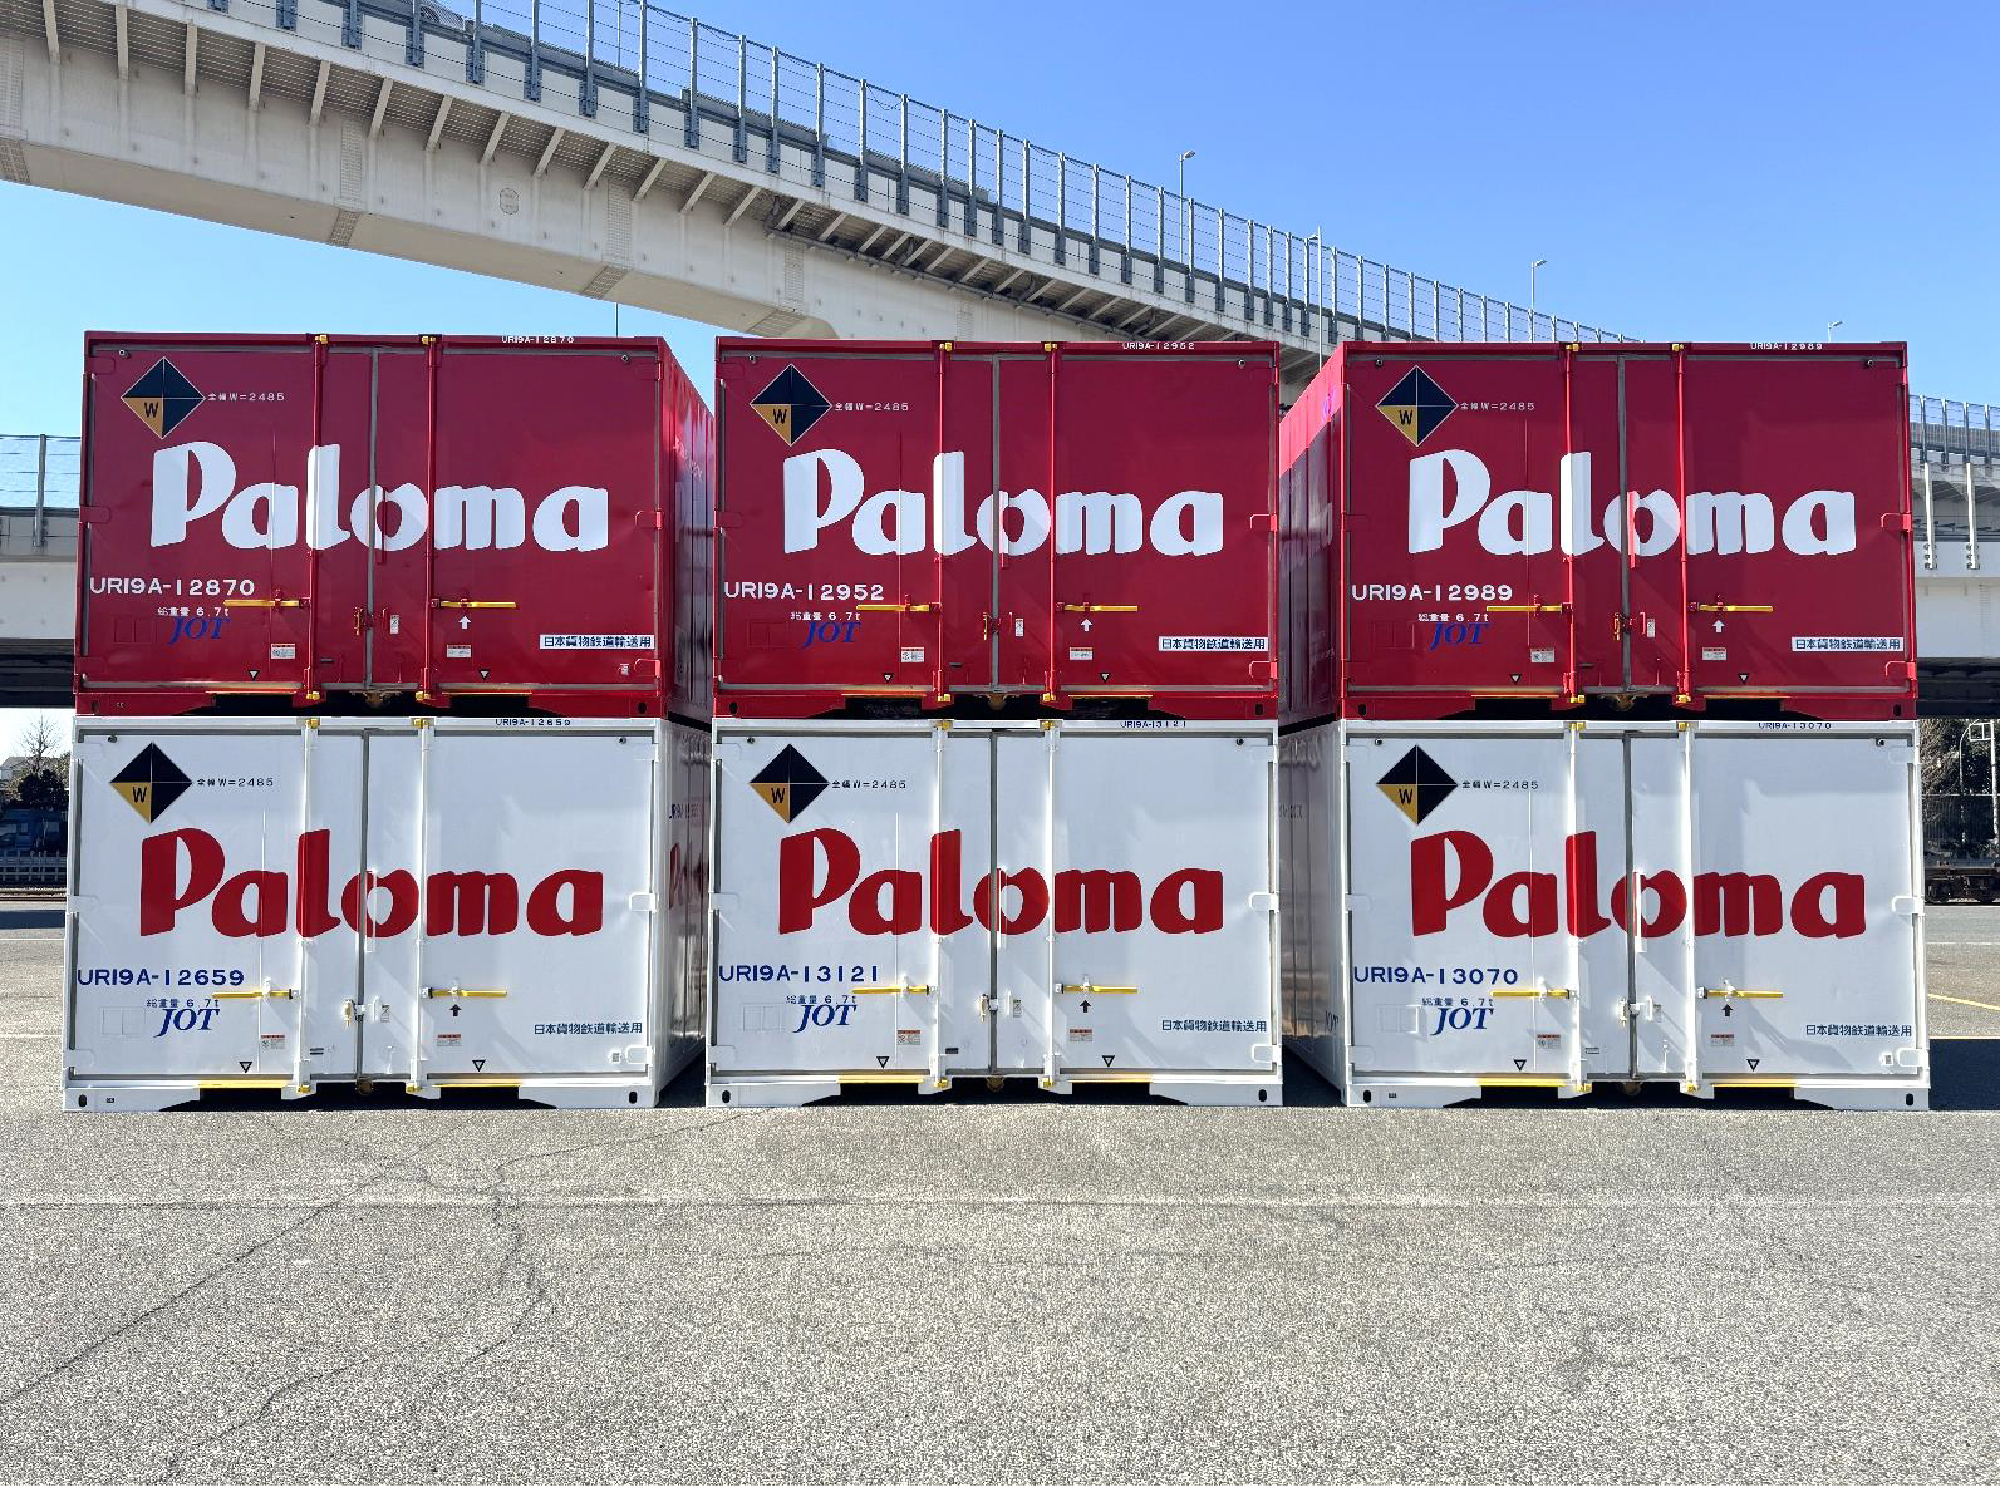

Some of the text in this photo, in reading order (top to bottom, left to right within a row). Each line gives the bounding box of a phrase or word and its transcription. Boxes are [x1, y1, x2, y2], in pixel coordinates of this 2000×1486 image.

[144, 402, 159, 418] W
[772, 408, 787, 424] W
[1399, 409, 1413, 425] W
[151, 441, 608, 552] Paloma
[783, 448, 1223, 556] Paloma
[1409, 448, 1857, 557] Paloma
[168, 616, 231, 644] JOT
[803, 621, 861, 648] JOT
[1430, 621, 1490, 650] JOT
[132, 786, 147, 802] W
[771, 787, 786, 803] W
[1399, 788, 1413, 804] W
[140, 827, 604, 938] Paloma
[778, 827, 1224, 936] Paloma
[1411, 830, 1866, 938] Paloma
[153, 1008, 220, 1038] JOT
[793, 1004, 856, 1034] JOT
[1431, 1007, 1494, 1036] JOT
